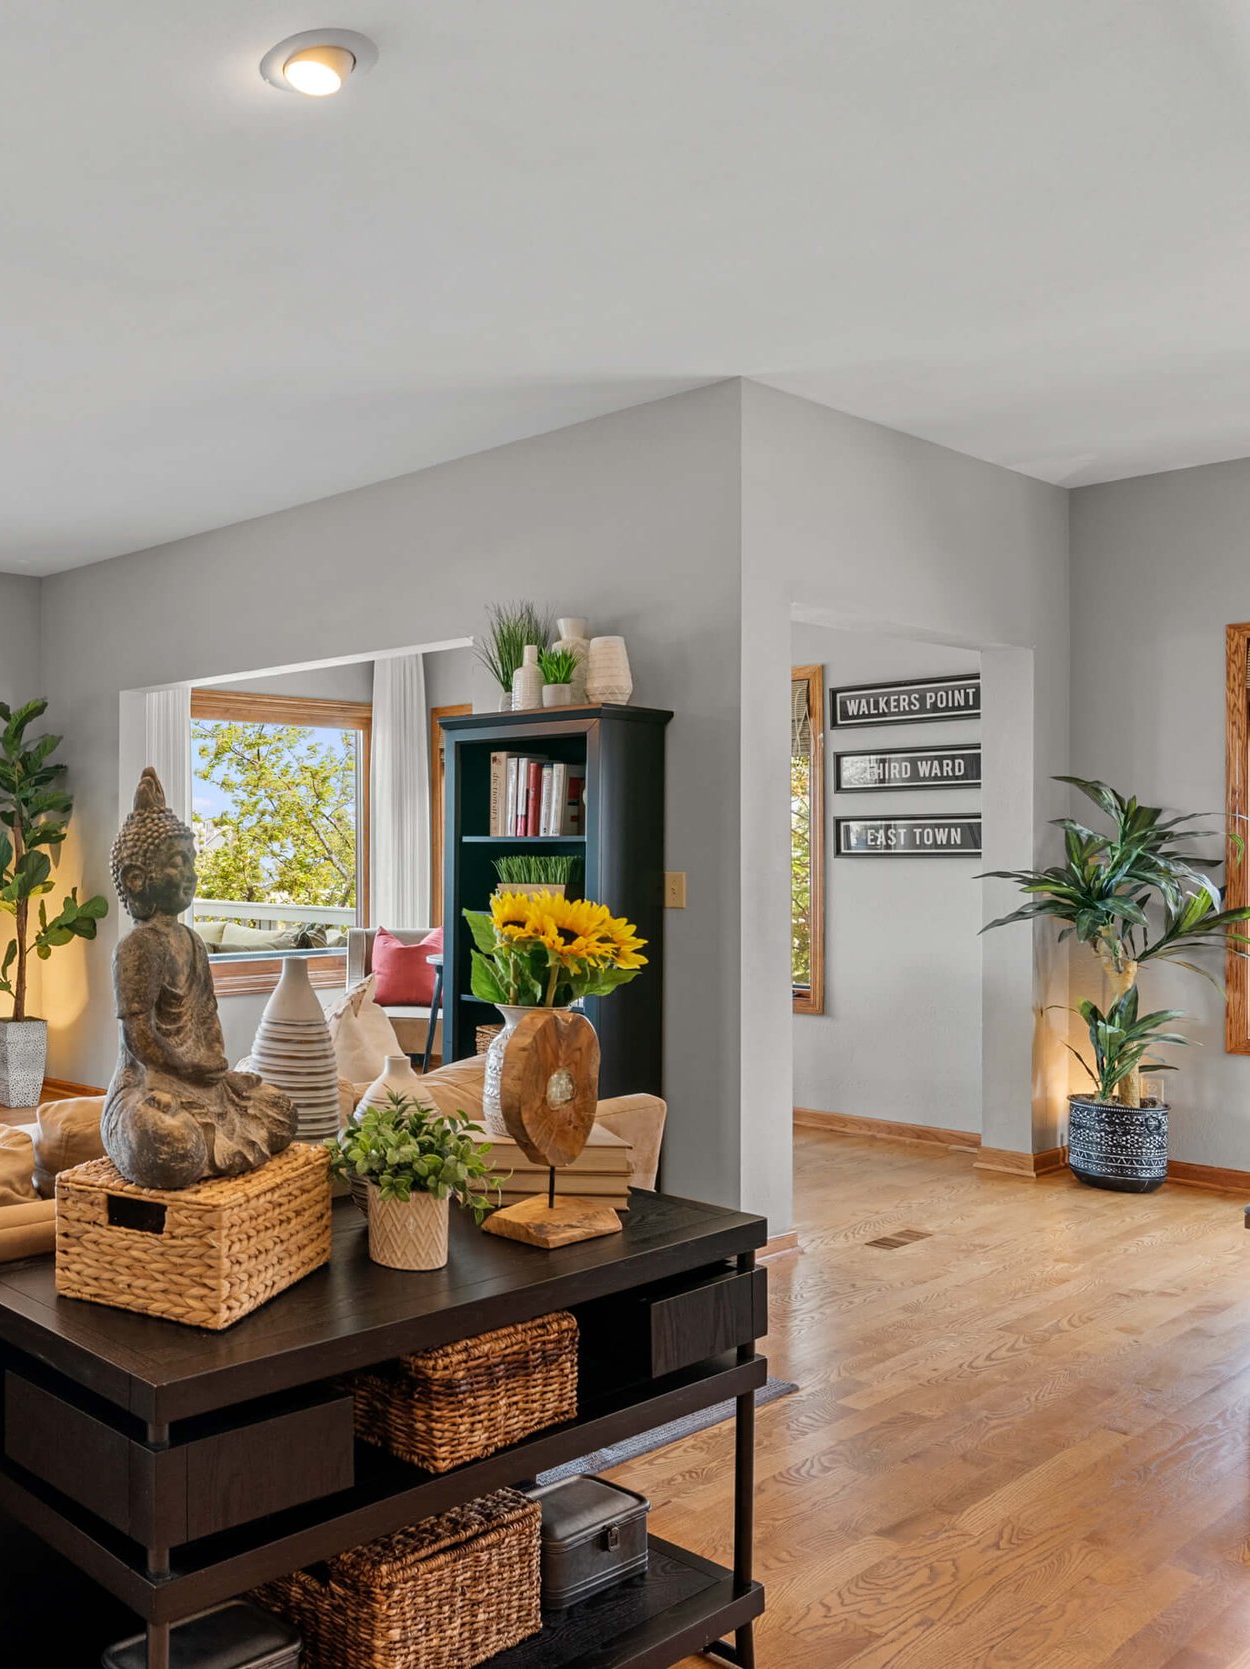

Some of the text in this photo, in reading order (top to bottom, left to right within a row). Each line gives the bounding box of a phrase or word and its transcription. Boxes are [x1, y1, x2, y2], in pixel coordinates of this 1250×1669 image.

[846, 688, 976, 716] WALKERS POINT
[917, 758, 965, 778] WARD
[866, 827, 962, 846] EAST TOWN
